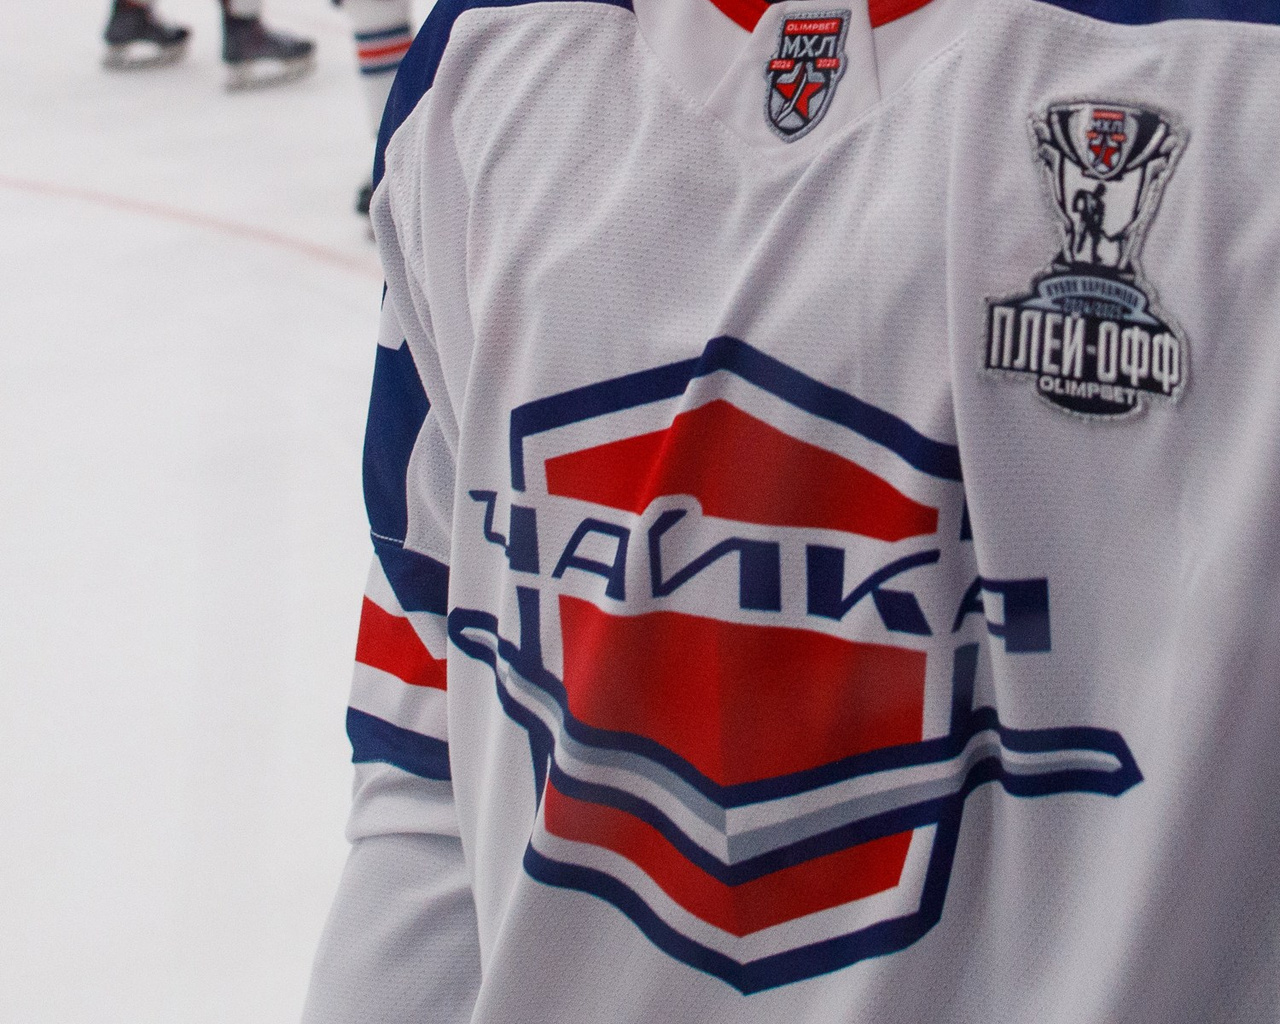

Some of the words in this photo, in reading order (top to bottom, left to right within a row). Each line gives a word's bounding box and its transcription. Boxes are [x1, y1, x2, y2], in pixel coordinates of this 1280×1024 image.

[787, 21, 837, 32] OLIMPBET
[781, 36, 837, 58] МХЛ
[989, 306, 1180, 393] ПЛЕЙ-ОФФ
[1039, 375, 1138, 405] OLIMPBET
[469, 490, 1052, 655] ЧАЙКА
